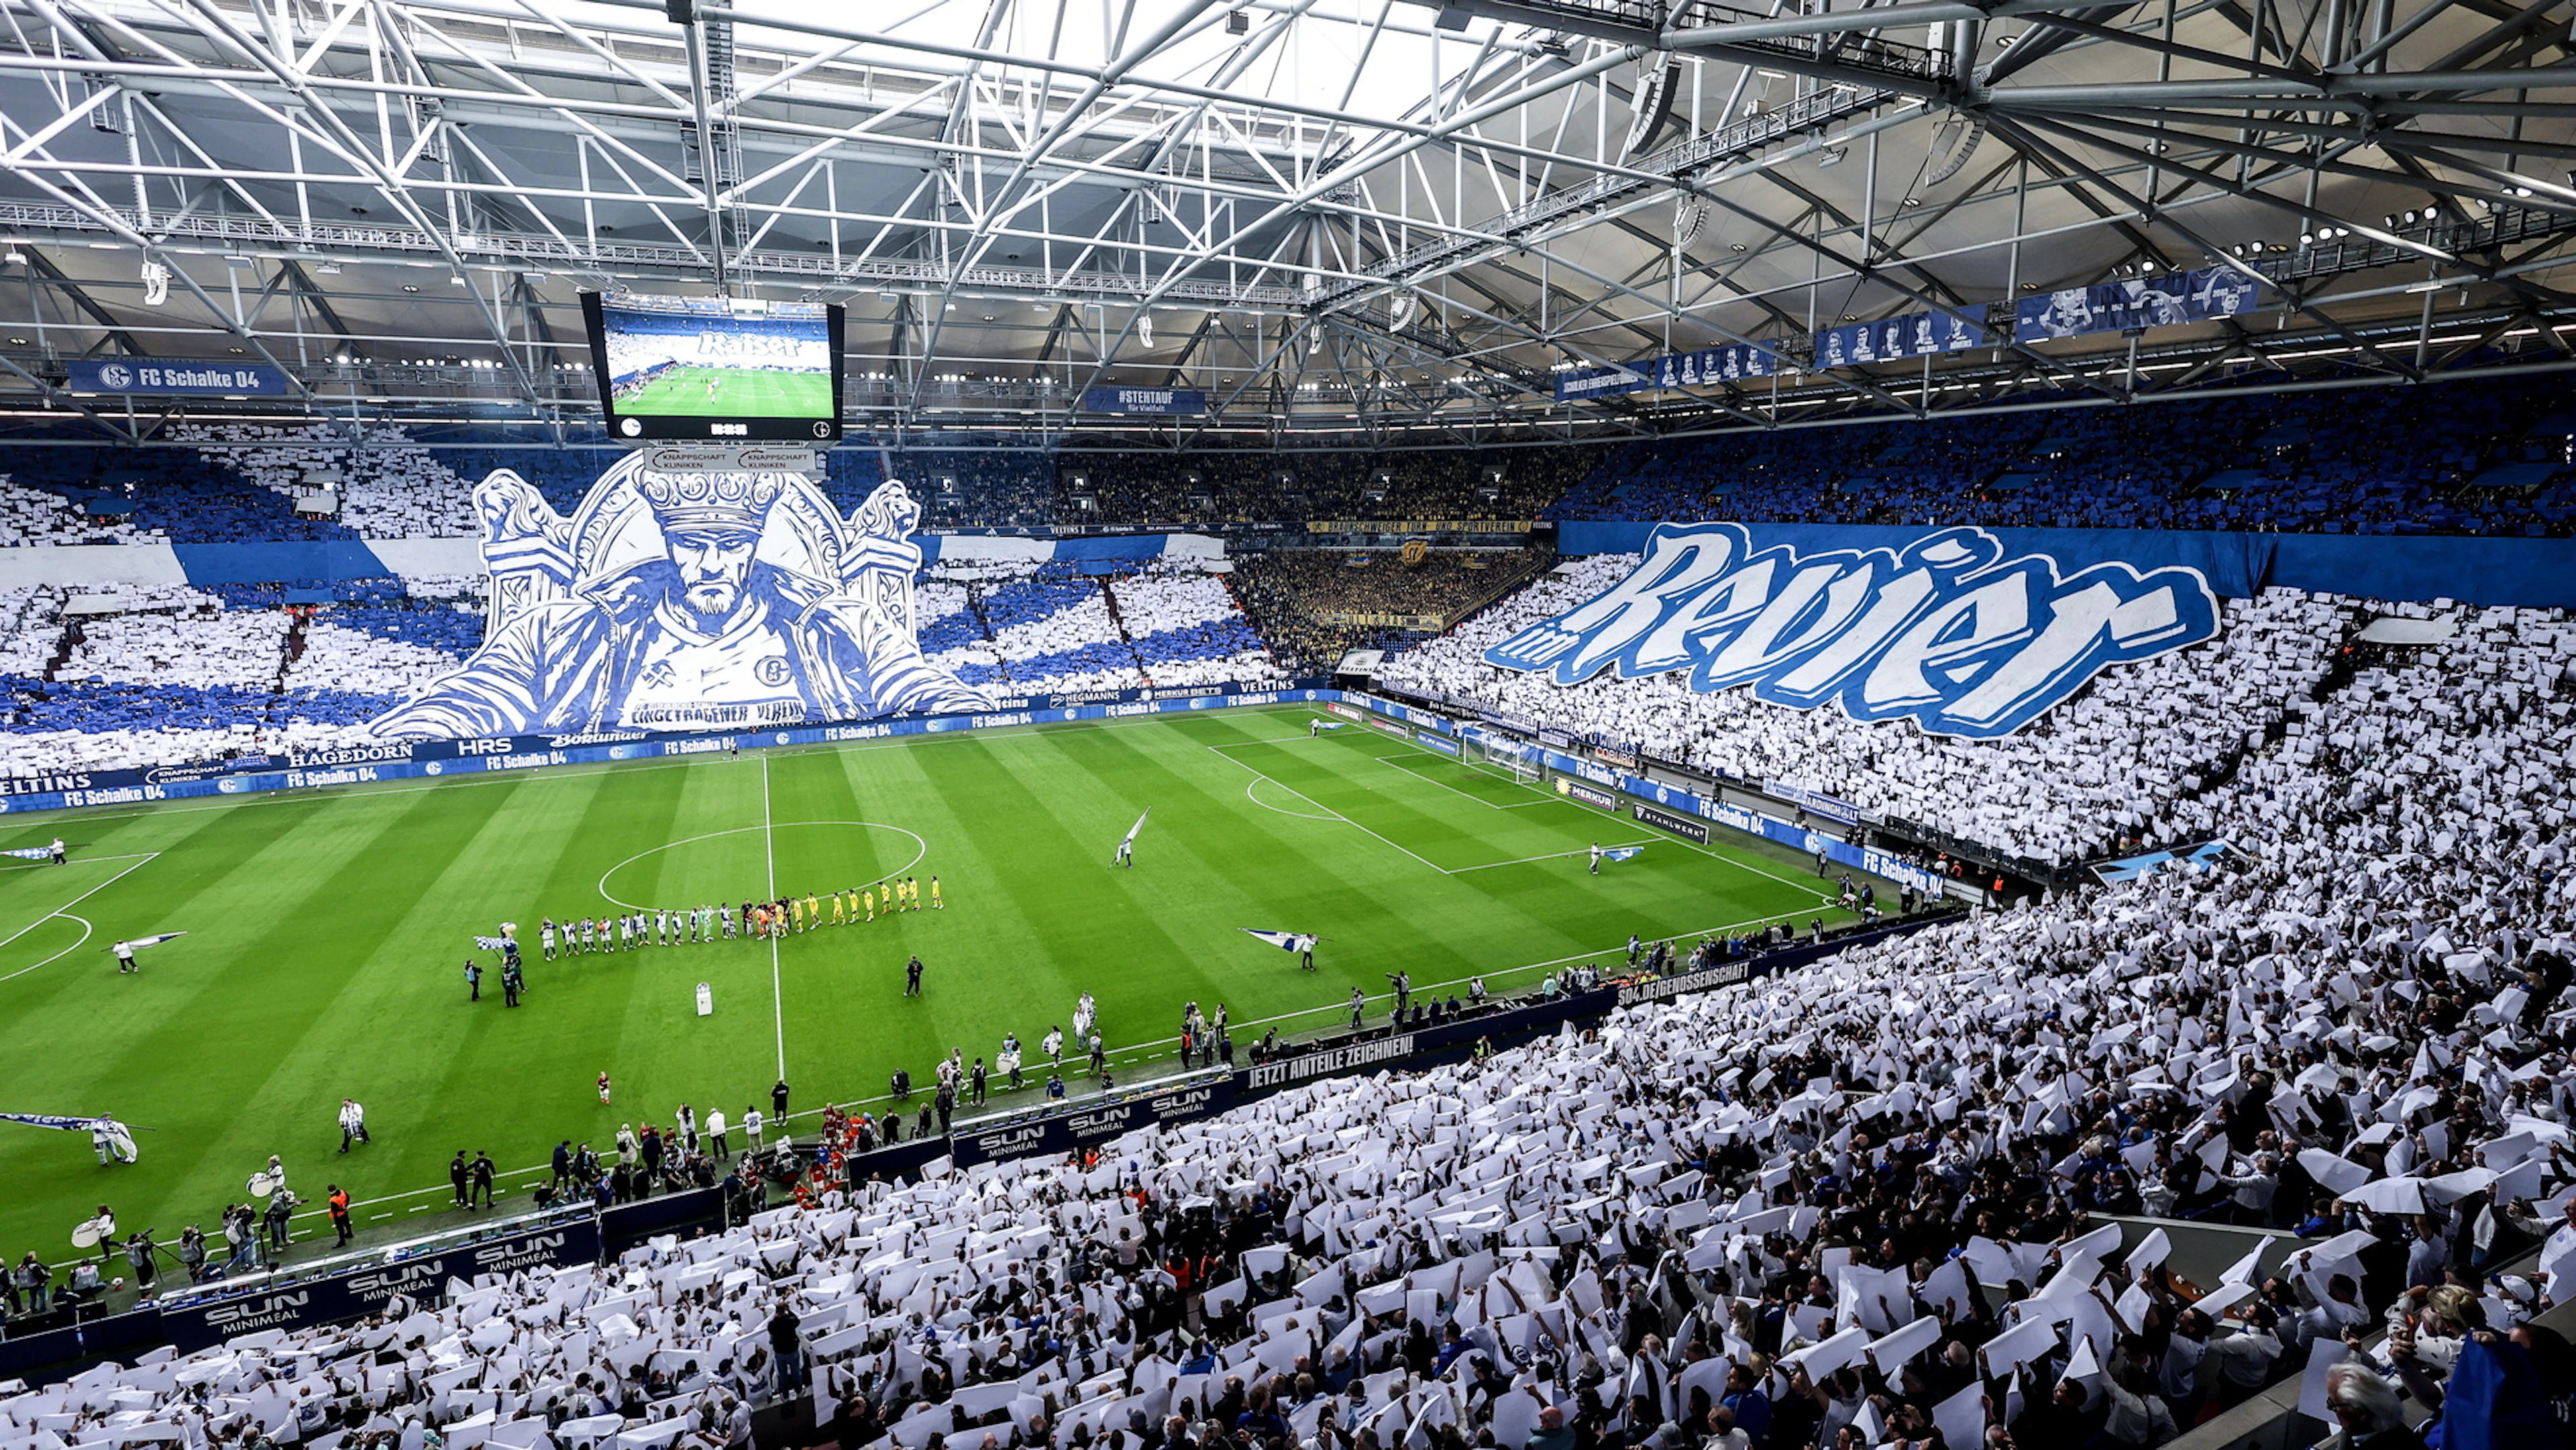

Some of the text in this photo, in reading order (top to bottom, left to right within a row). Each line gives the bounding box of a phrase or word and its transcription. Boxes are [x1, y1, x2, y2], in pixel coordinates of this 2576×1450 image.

[698, 331, 803, 357] Kaiser
[139, 368, 260, 388] FC Schalke 04
[1119, 390, 1173, 404] #STEHTAUF
[663, 454, 808, 462] KNAPPSCHAFT KNAPPSCHAFT
[1051, 526, 1079, 534] VELTINS
[1329, 521, 1401, 532] BRAUNSCHWEIGER
[1436, 522, 1452, 531] UND
[1457, 522, 1515, 532] SPORTVEREIN
[1560, 532, 2187, 726] Revier
[1498, 622, 1580, 666] im
[1065, 691, 1120, 703] HEGMANNS
[1155, 688, 1189, 699] MERKUR
[1240, 680, 1295, 693] VELTINS
[1106, 702, 1161, 717] FC Schalke 04
[1228, 692, 1278, 706] FC Schalke 04
[631, 701, 806, 724] EINGETRAGENER VEREIN
[972, 711, 1032, 728] FC Schalke 04
[825, 724, 891, 740] FC Schalke 04
[289, 744, 413, 767] HAGEDORN
[458, 737, 513, 756] HRS
[665, 741, 678, 755] FC
[681, 739, 720, 754] Schalke
[1595, 746, 1636, 767] COBURG
[486, 756, 501, 770] FC
[504, 754, 548, 769] Schalke
[551, 751, 567, 764] 04
[158, 766, 224, 777] KNAPPSCHAFT
[160, 775, 201, 784] KLINIKEN
[287, 766, 377, 788] FC Schalke 04
[64, 791, 84, 807] FC
[87, 788, 143, 804] Schalke
[145, 784, 166, 800] 04
[1572, 786, 1612, 807] MERKUR
[1699, 799, 1765, 836] FC Schalke 04
[1864, 851, 1943, 899] FC Schalke 04
[1618, 962, 1750, 1006] S04.DE/GENOSSENSCHAFT
[1248, 1035, 1413, 1089] JETZT ANTEILE ZEICHNEN!
[1152, 1088, 1212, 1112] SUN
[1068, 1106, 1130, 1131] SUN
[1160, 1103, 1205, 1119] MINIMEAL
[979, 1125, 1045, 1150] SUN
[1077, 1121, 1124, 1137] MINIMEAL
[987, 1140, 1038, 1157] MINIMEAL
[475, 1233, 565, 1265] SUN
[490, 1249, 556, 1273] MINIMEAL
[347, 1260, 443, 1294] SUN
[363, 1278, 435, 1302] MINIMEAL
[205, 1290, 309, 1325] SUN
[222, 1309, 300, 1334] MINIMEAL
